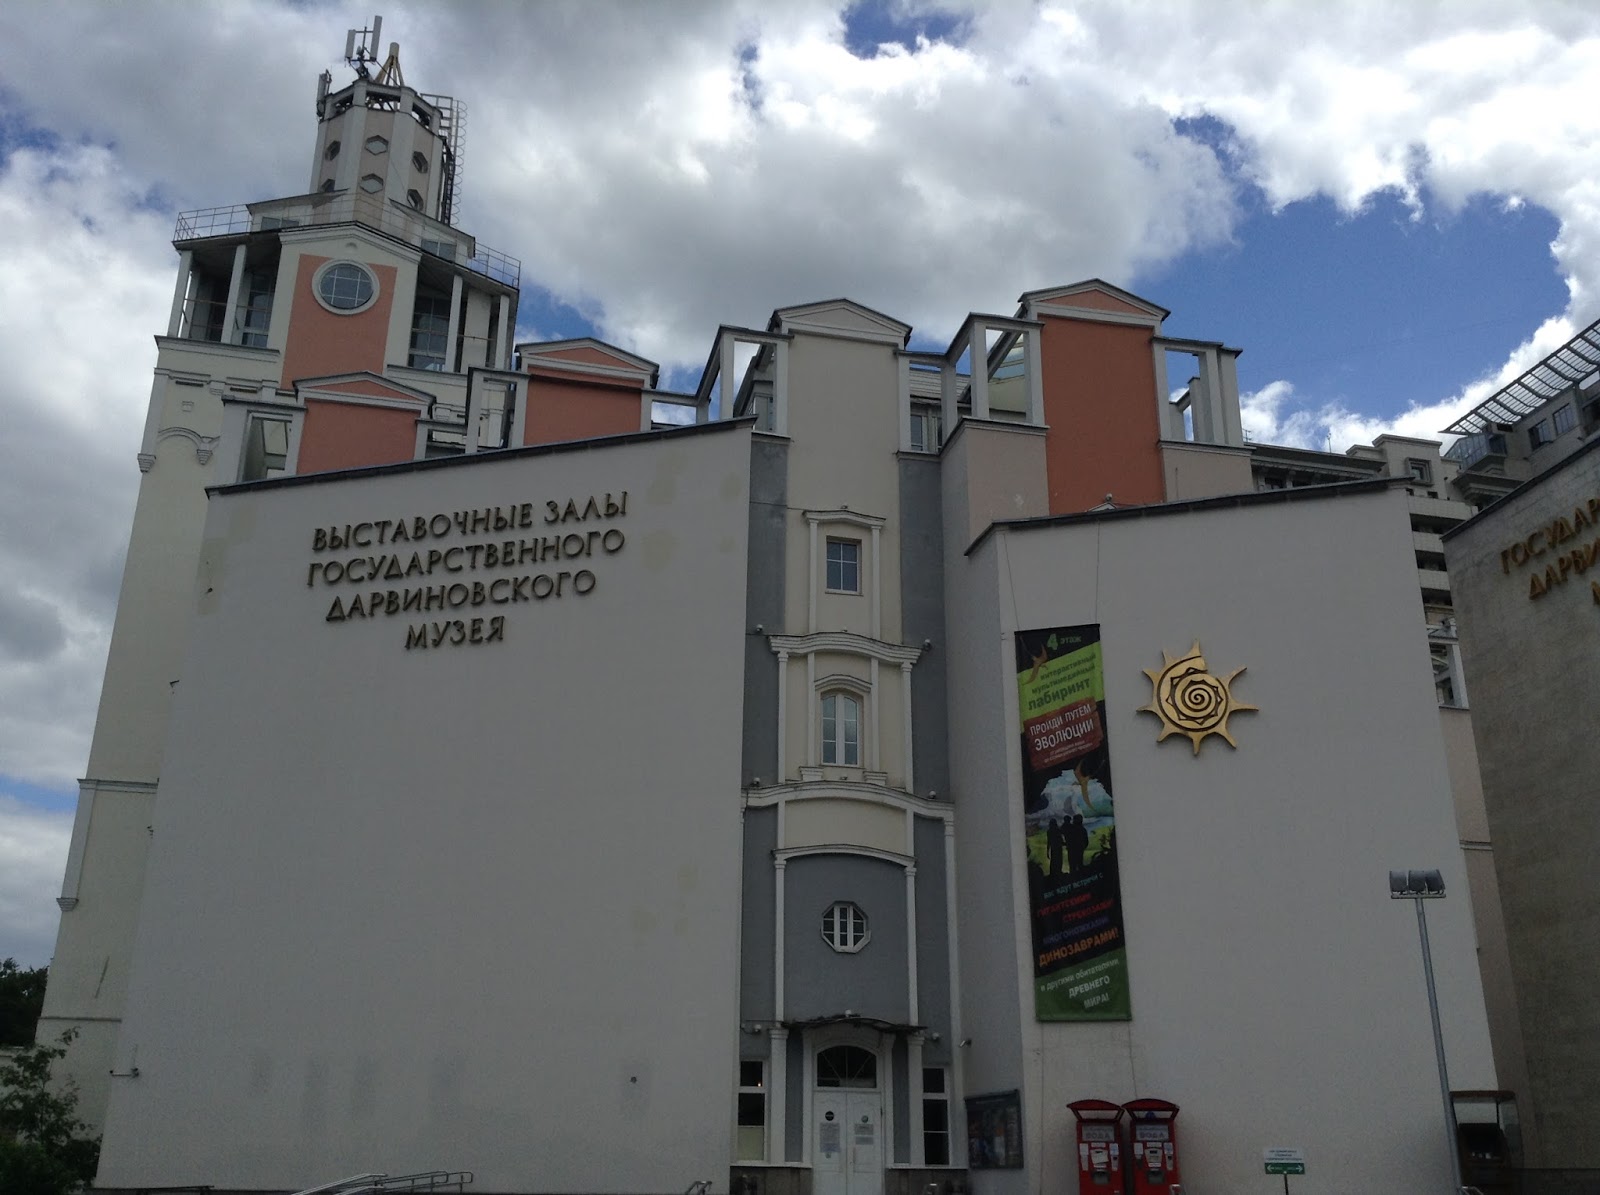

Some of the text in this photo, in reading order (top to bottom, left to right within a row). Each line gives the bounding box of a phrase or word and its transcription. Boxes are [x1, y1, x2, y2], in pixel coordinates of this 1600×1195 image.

[312, 491, 628, 552] ВЫСТАВОЧНЫЕ ЗАЛЫ
[307, 529, 626, 586] ГОСУДАРСТВЕННОГО
[325, 569, 597, 622] ДАРВИНОВСКОГО
[404, 615, 505, 650] МУЗЕЯ
[1047, 633, 1058, 651] 4
[1028, 679, 1090, 710] лабиринт
[1034, 719, 1094, 751] ЭВОЛЮЦИИ
[1039, 927, 1119, 967] ДИНОЗАВРАМИ!
[1069, 975, 1110, 999] ДРЕВНЕГО
[1083, 993, 1110, 1009] МИРА!
